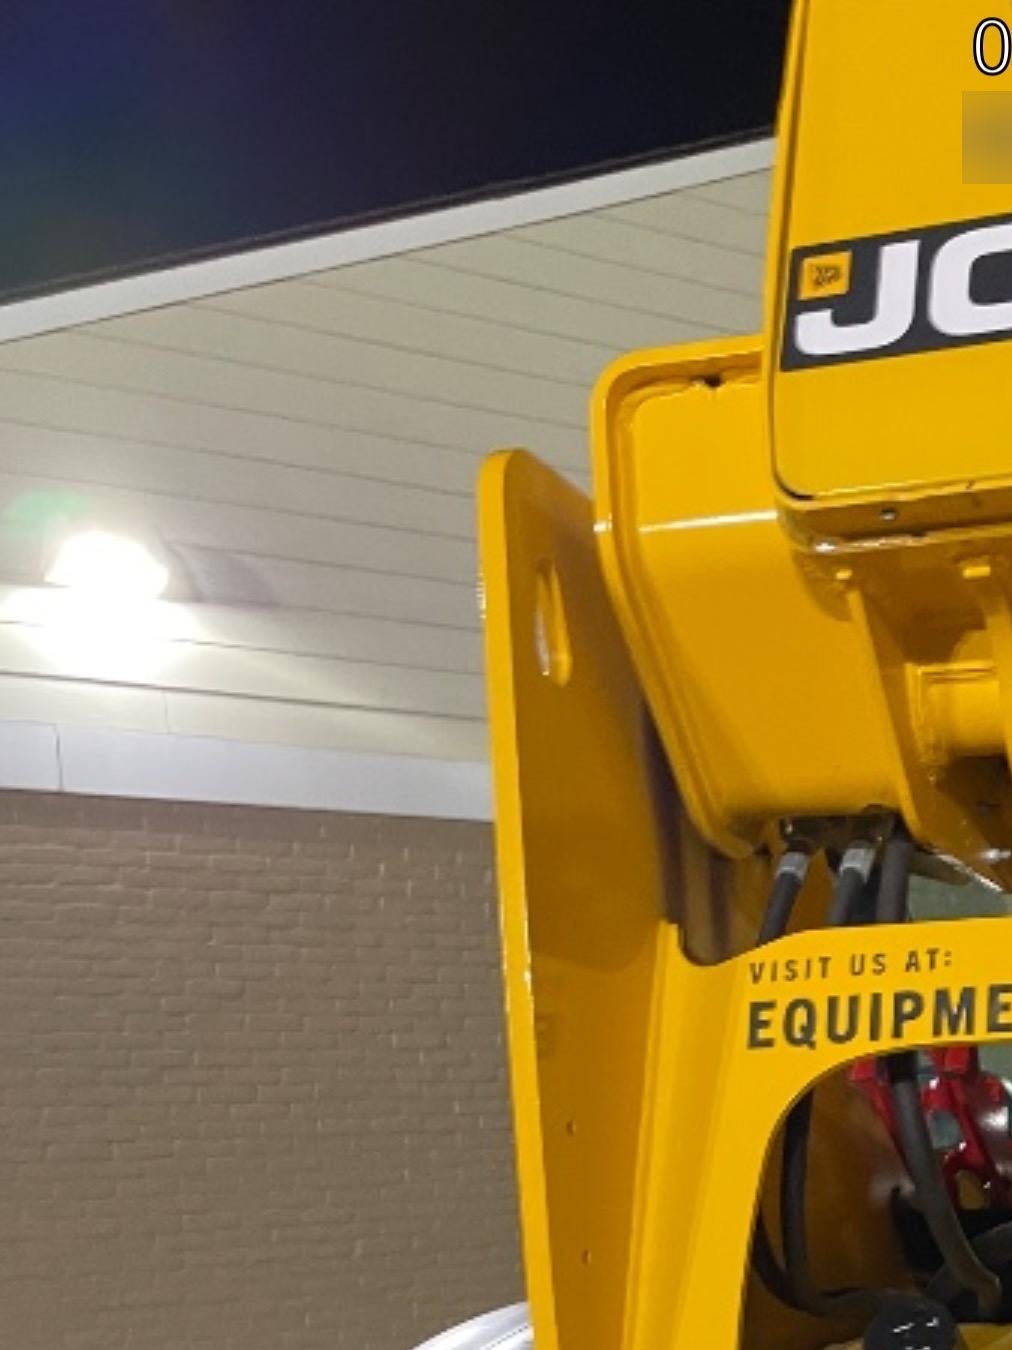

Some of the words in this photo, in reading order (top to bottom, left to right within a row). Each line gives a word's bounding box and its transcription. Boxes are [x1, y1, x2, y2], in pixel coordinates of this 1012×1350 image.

[750, 956, 832, 985] VISIT
[850, 952, 887, 977] US
[904, 947, 953, 973] AT:
